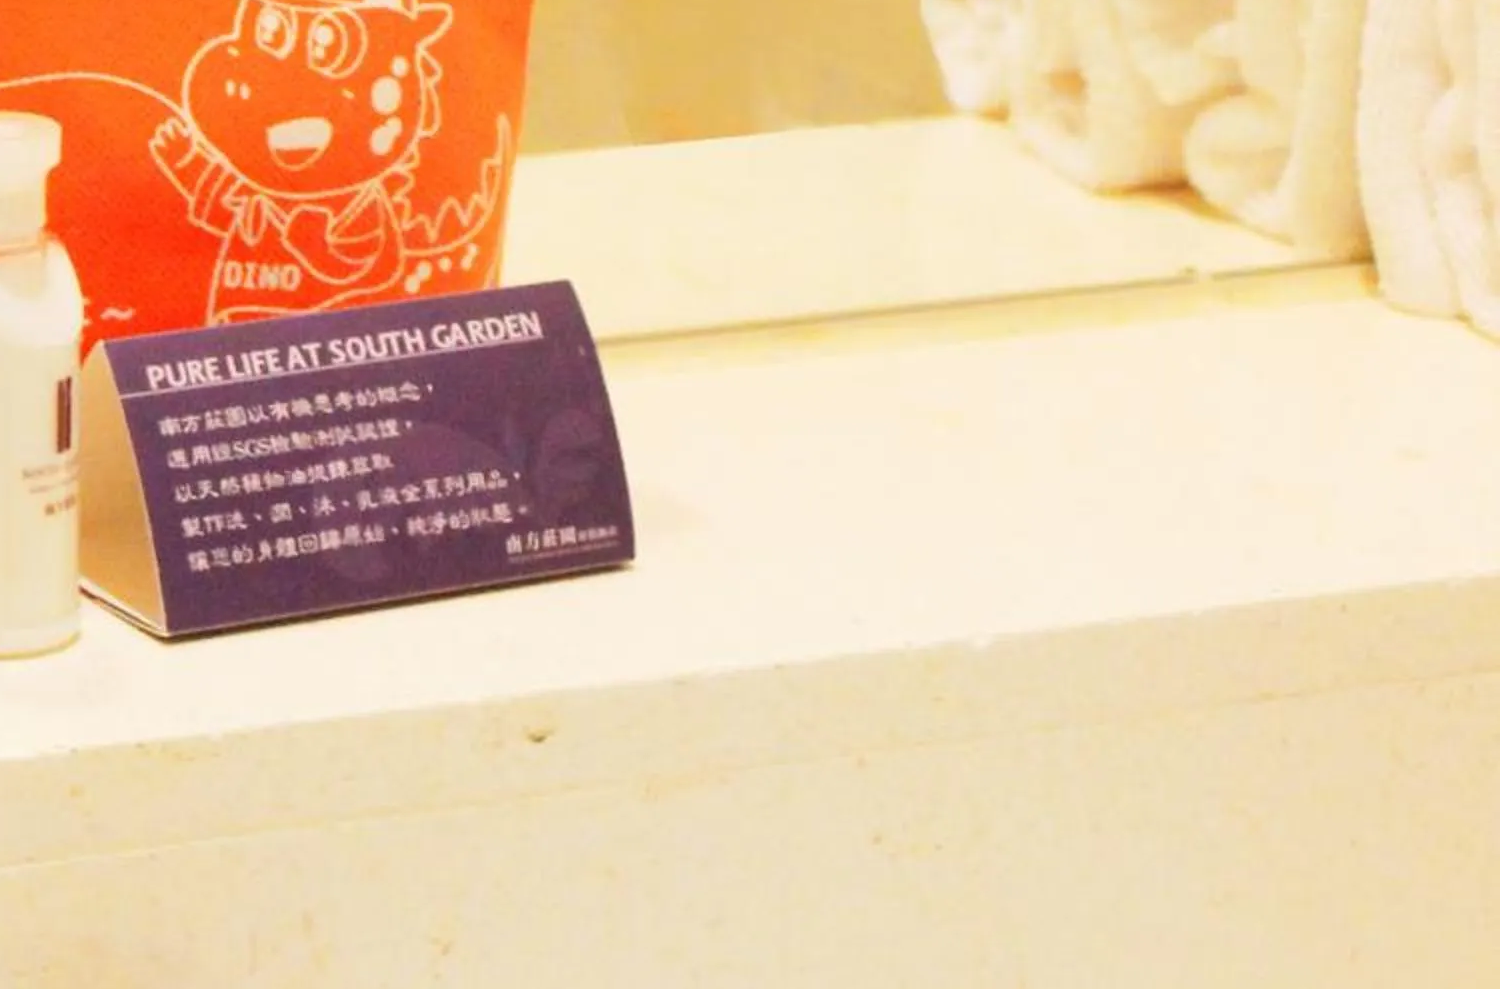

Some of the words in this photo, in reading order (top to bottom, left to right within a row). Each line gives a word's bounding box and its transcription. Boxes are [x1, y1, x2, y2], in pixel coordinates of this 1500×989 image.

[223, 259, 303, 292] DINO
[145, 351, 222, 391] PURE
[225, 345, 282, 378] LIFE
[286, 342, 322, 370] AT
[329, 324, 428, 364] SOUTH
[430, 311, 542, 349] GARDEN
